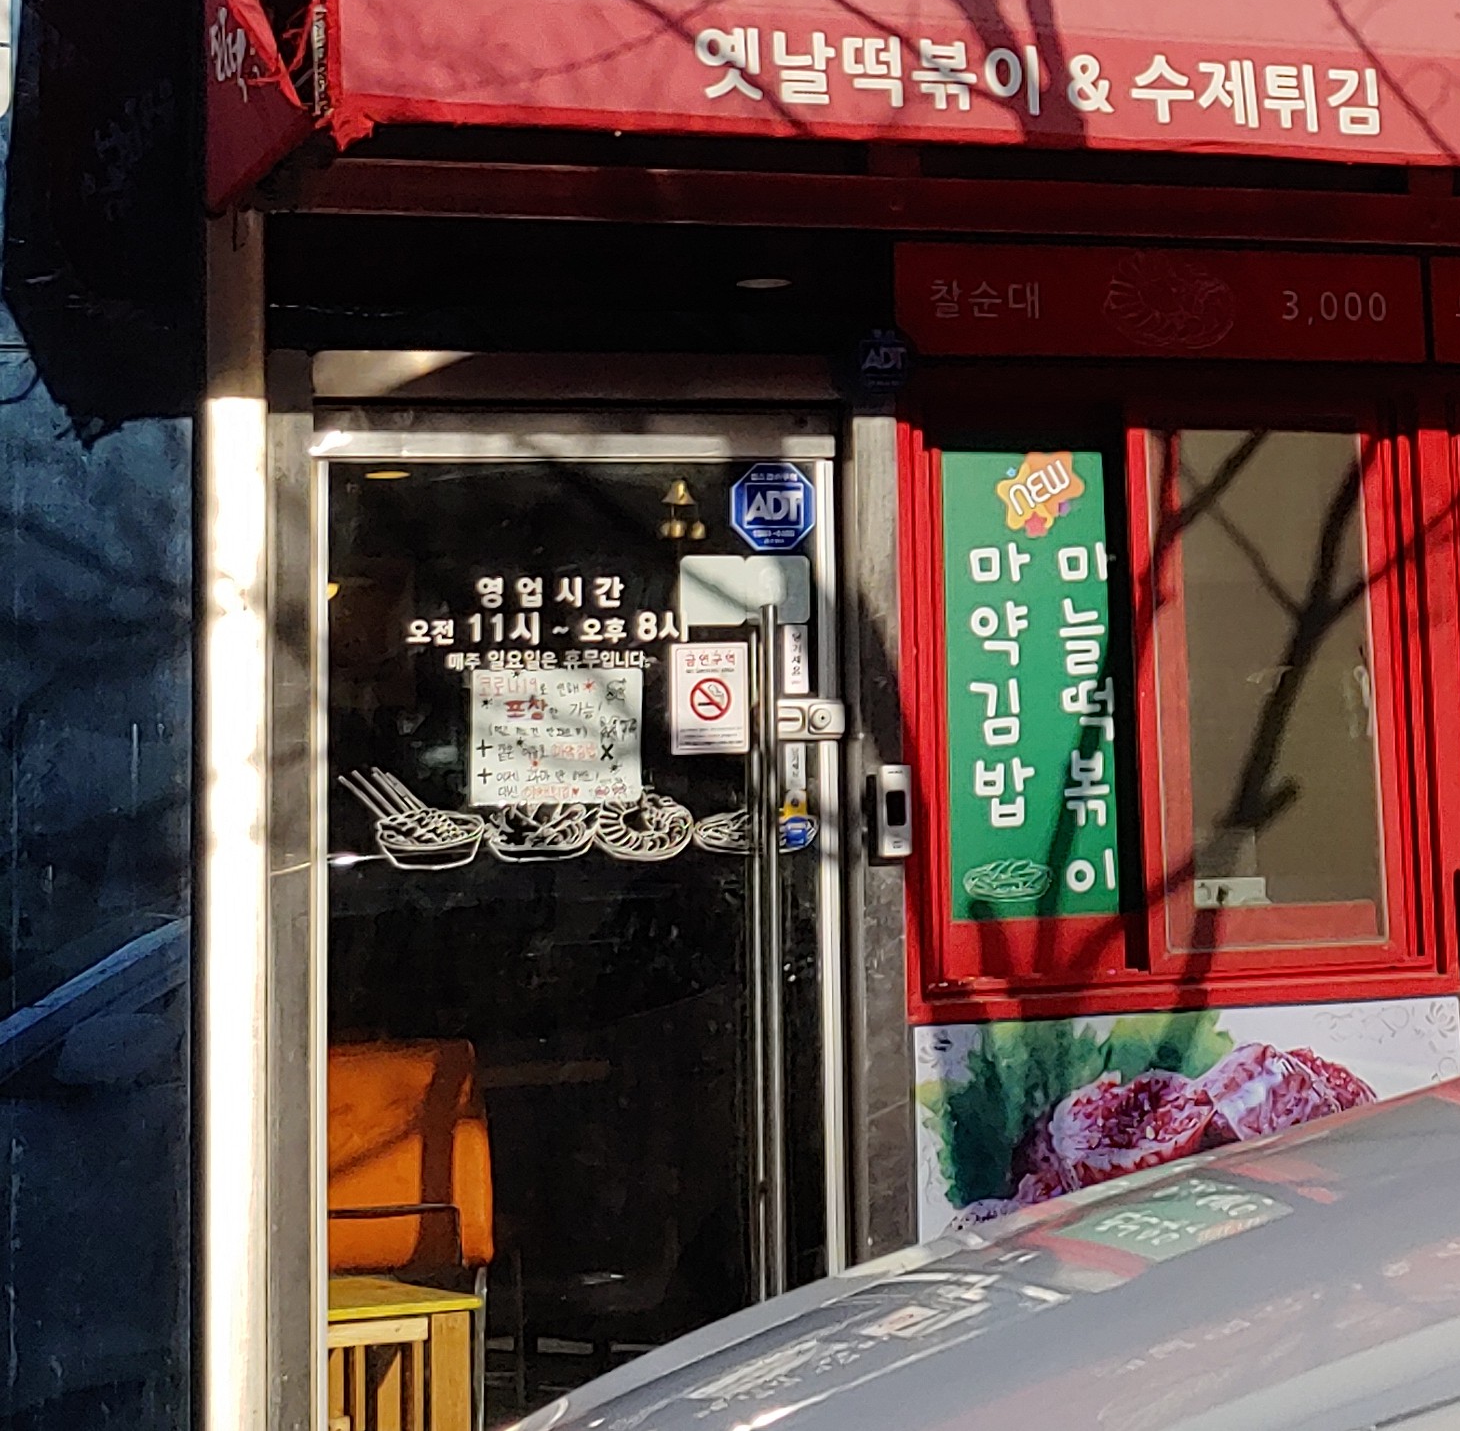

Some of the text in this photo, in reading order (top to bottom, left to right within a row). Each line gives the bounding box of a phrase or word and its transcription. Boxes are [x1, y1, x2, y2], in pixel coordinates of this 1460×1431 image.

[695, 25, 1382, 136] 옛날떡볶이 & 수제튀김
[929, 280, 1388, 327] 찰순대 3,000
[861, 346, 908, 371] ADT
[1006, 458, 1072, 516] NEW
[745, 490, 803, 522] ADT
[477, 576, 625, 609] 영업시간
[405, 619, 454, 646] 오전
[469, 612, 540, 645] 11시
[579, 618, 627, 643] 오후
[637, 611, 688, 642] 8시
[447, 651, 481, 670] 매주
[487, 649, 558, 670] 일요일은
[685, 649, 736, 668] 금연구역
[969, 541, 1034, 828] 마약김밥
[1057, 541, 1116, 891] 마늘떡볶이
